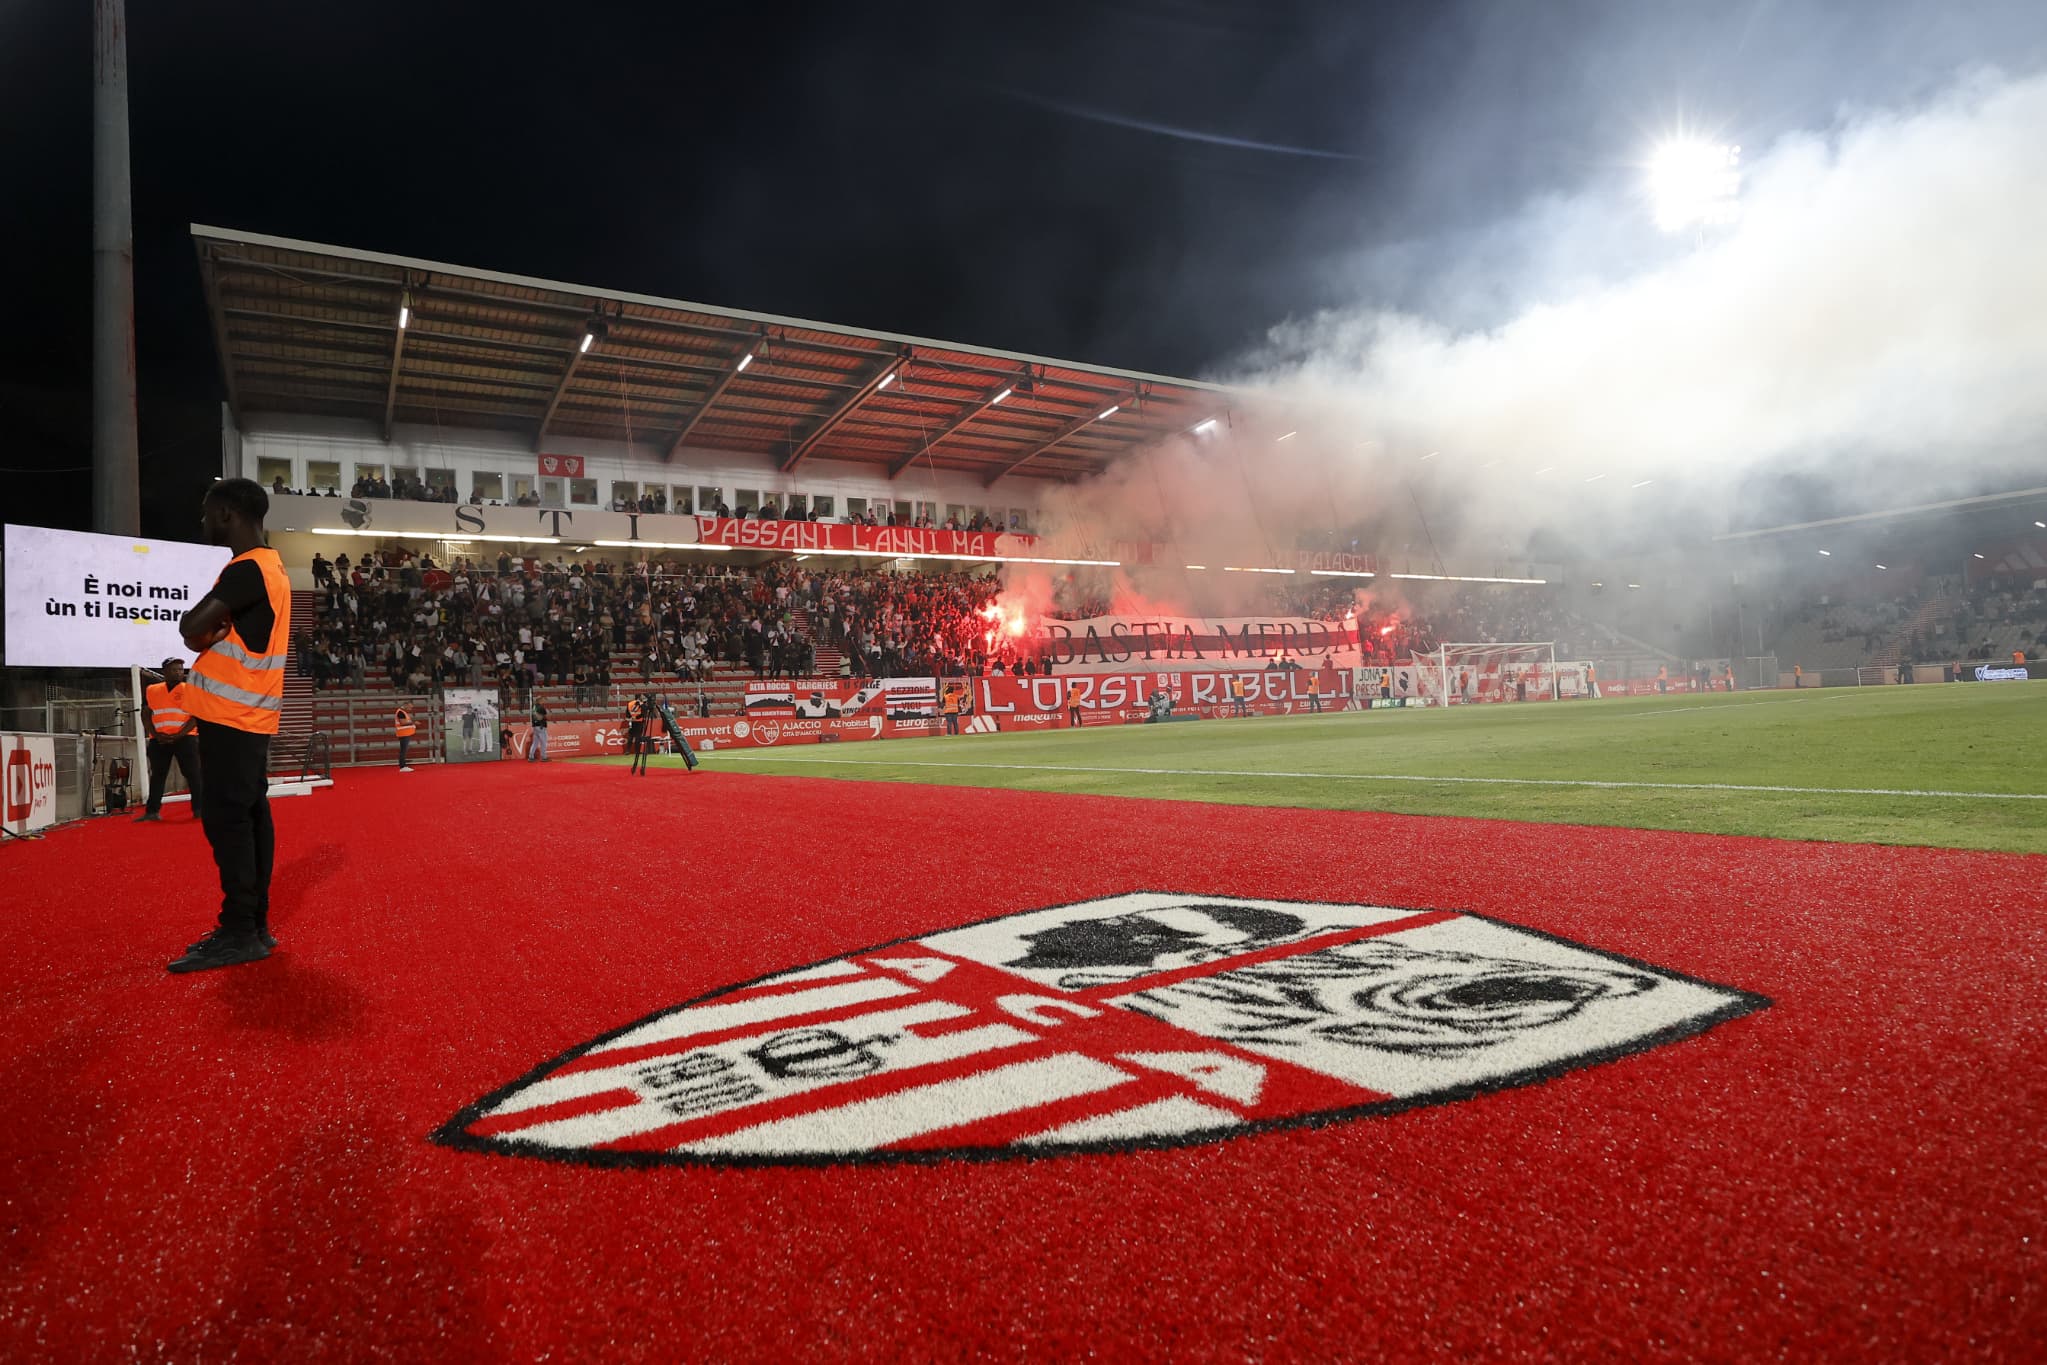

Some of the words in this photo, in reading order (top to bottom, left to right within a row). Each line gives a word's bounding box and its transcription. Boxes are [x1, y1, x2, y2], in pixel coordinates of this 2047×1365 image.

[699, 517, 832, 549] PASSANI
[853, 526, 938, 554] L'ANNI
[952, 532, 985, 555] MA
[84, 574, 99, 595] È
[107, 582, 142, 597] noi
[149, 585, 188, 601] mai
[45, 598, 76, 616] ùn
[84, 601, 100, 618] ti
[1047, 623, 1204, 664] BASTIA
[1217, 622, 1356, 659] MERDA
[982, 676, 1149, 712] L'ORSI
[1191, 670, 1350, 704] RIBELLI
[709, 724, 731, 735] vert
[782, 720, 822, 730] AJACCIO
[829, 720, 842, 728] AZ
[34, 757, 53, 789] ctm
